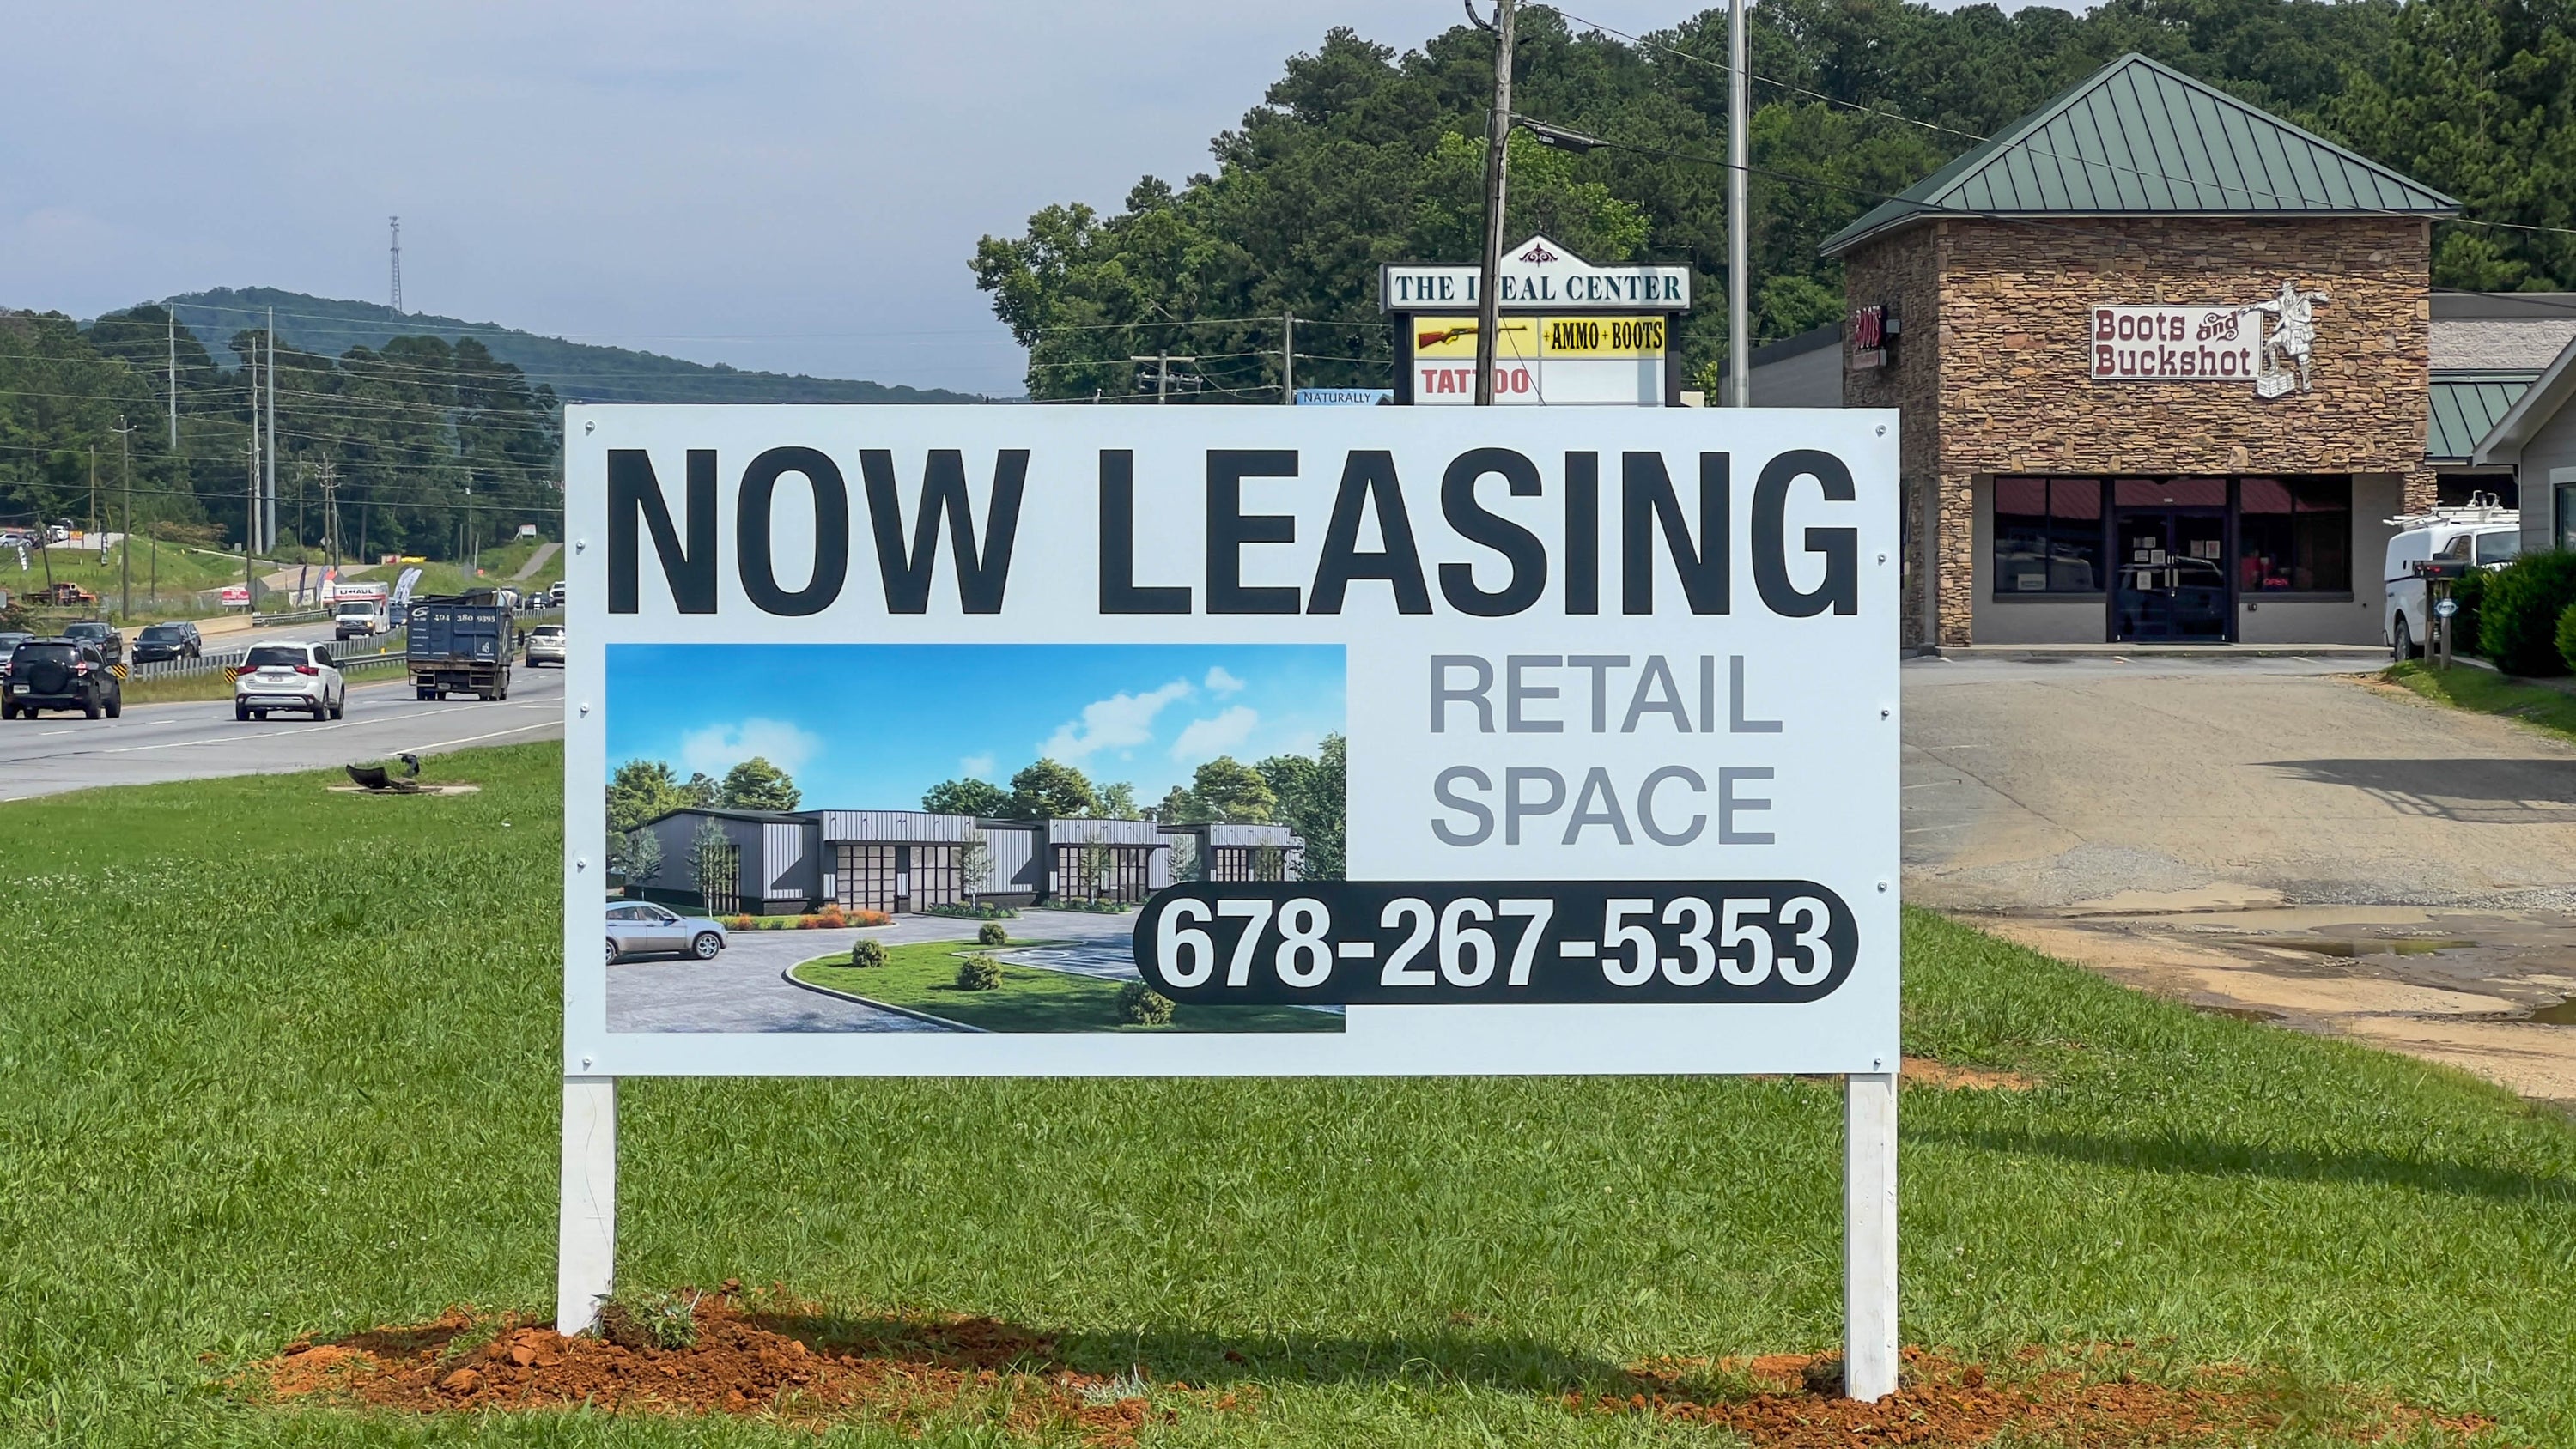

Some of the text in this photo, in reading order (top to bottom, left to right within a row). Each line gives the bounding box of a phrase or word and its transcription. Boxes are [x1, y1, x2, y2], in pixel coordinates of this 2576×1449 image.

[1395, 275, 1683, 301] THE IEAL CENTER
[1612, 321, 1663, 349] BOOTS
[2095, 309, 2239, 342] Boots and
[2095, 344, 2251, 376] Buckshot
[1421, 368, 1529, 394] TATOO
[1303, 392, 1371, 403] NATURALLY
[607, 446, 1858, 618] NOW LEASING
[456, 613, 474, 622] 380
[1430, 654, 1783, 734] RETAIL
[1430, 765, 1776, 847] SPACE
[1155, 895, 1834, 989] 678-267-5353
